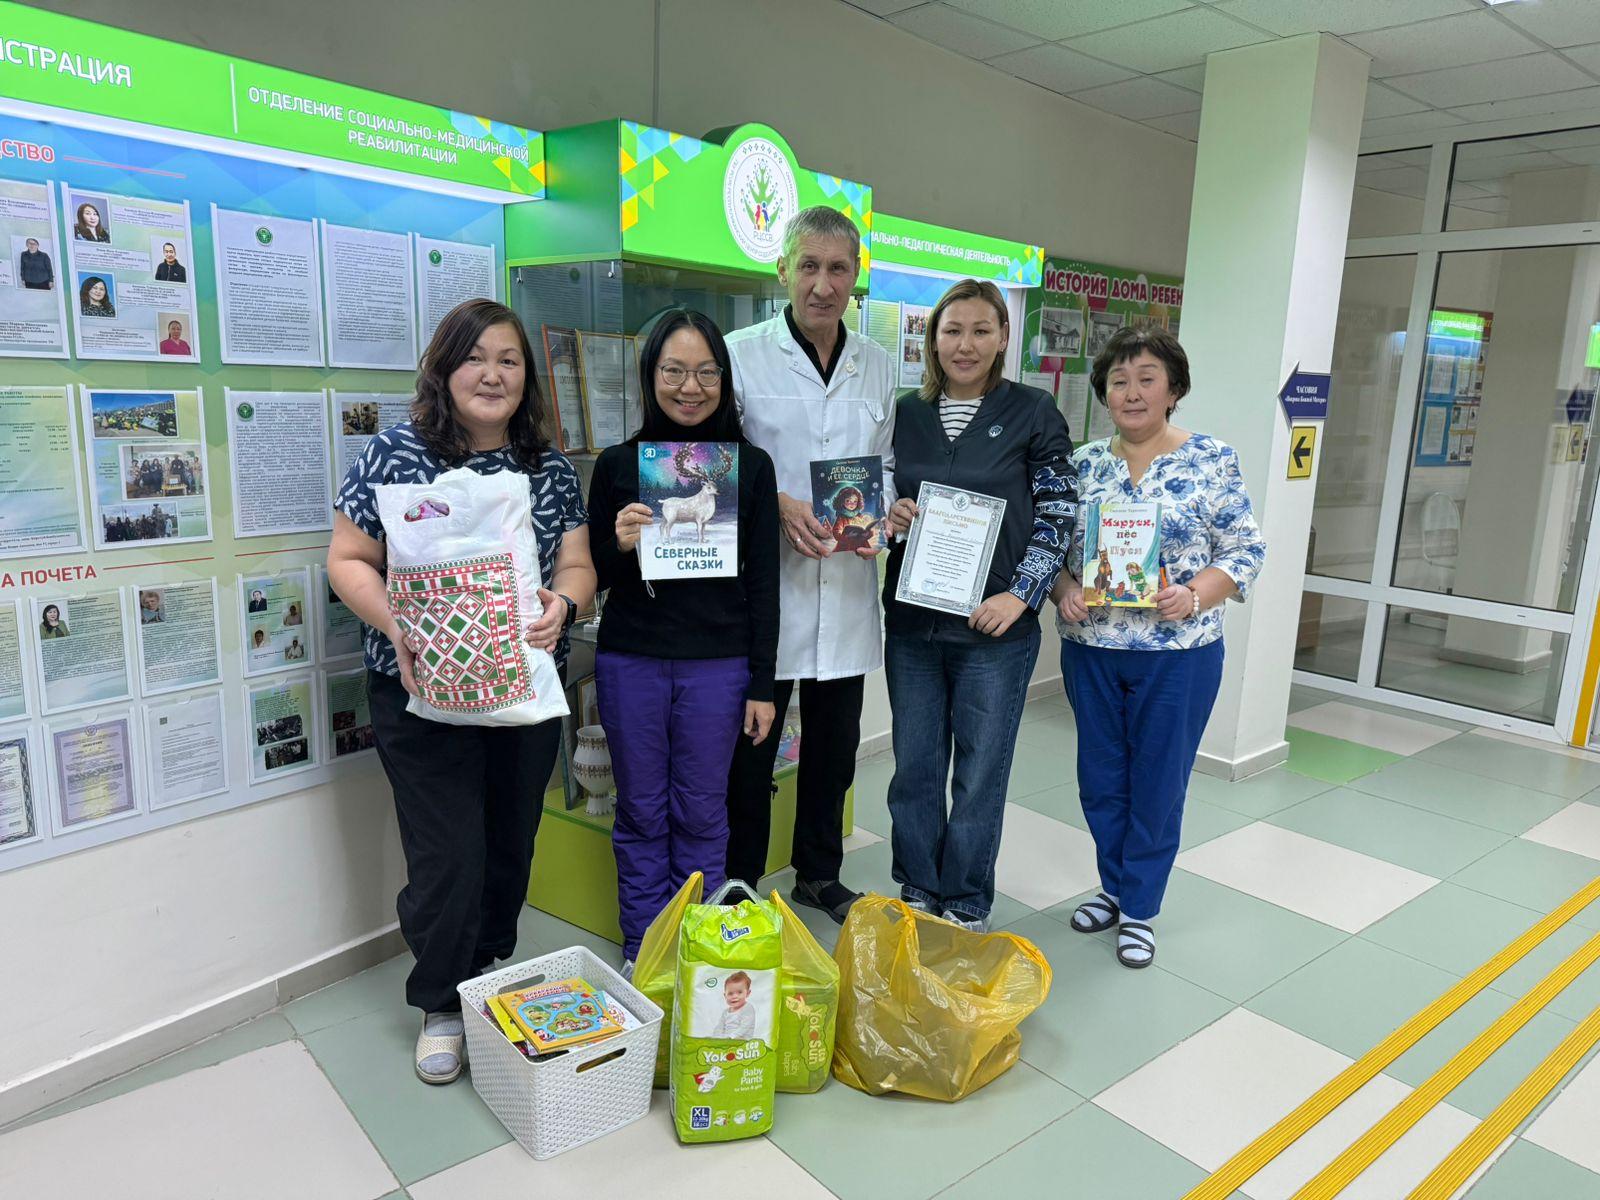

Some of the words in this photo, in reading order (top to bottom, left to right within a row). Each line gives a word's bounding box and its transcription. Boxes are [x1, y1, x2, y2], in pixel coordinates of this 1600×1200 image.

[248, 86, 344, 122] ОТДЕЛЕНИЕ
[348, 108, 529, 162] СОЦИАЛЬНО-МЕДИЦИНСКОЙ
[0, 139, 55, 164] СТВО
[348, 129, 457, 165] РЕАБИЛИТАЦИИ
[963, 249, 1011, 267] ДЕЯТЕЛЬНОСТЬ
[1045, 269, 1108, 299] ИСТОРИЯ
[1111, 279, 1148, 302] ДОМА
[830, 466, 867, 475] ДЕВОЧКА
[843, 470, 871, 481] СЕРДЦЕ
[20, 564, 97, 586] ПОЧЕТА
[741, 1076, 764, 1085] Pants
[743, 1067, 764, 1077] Baby
[694, 1107, 709, 1117] XL
